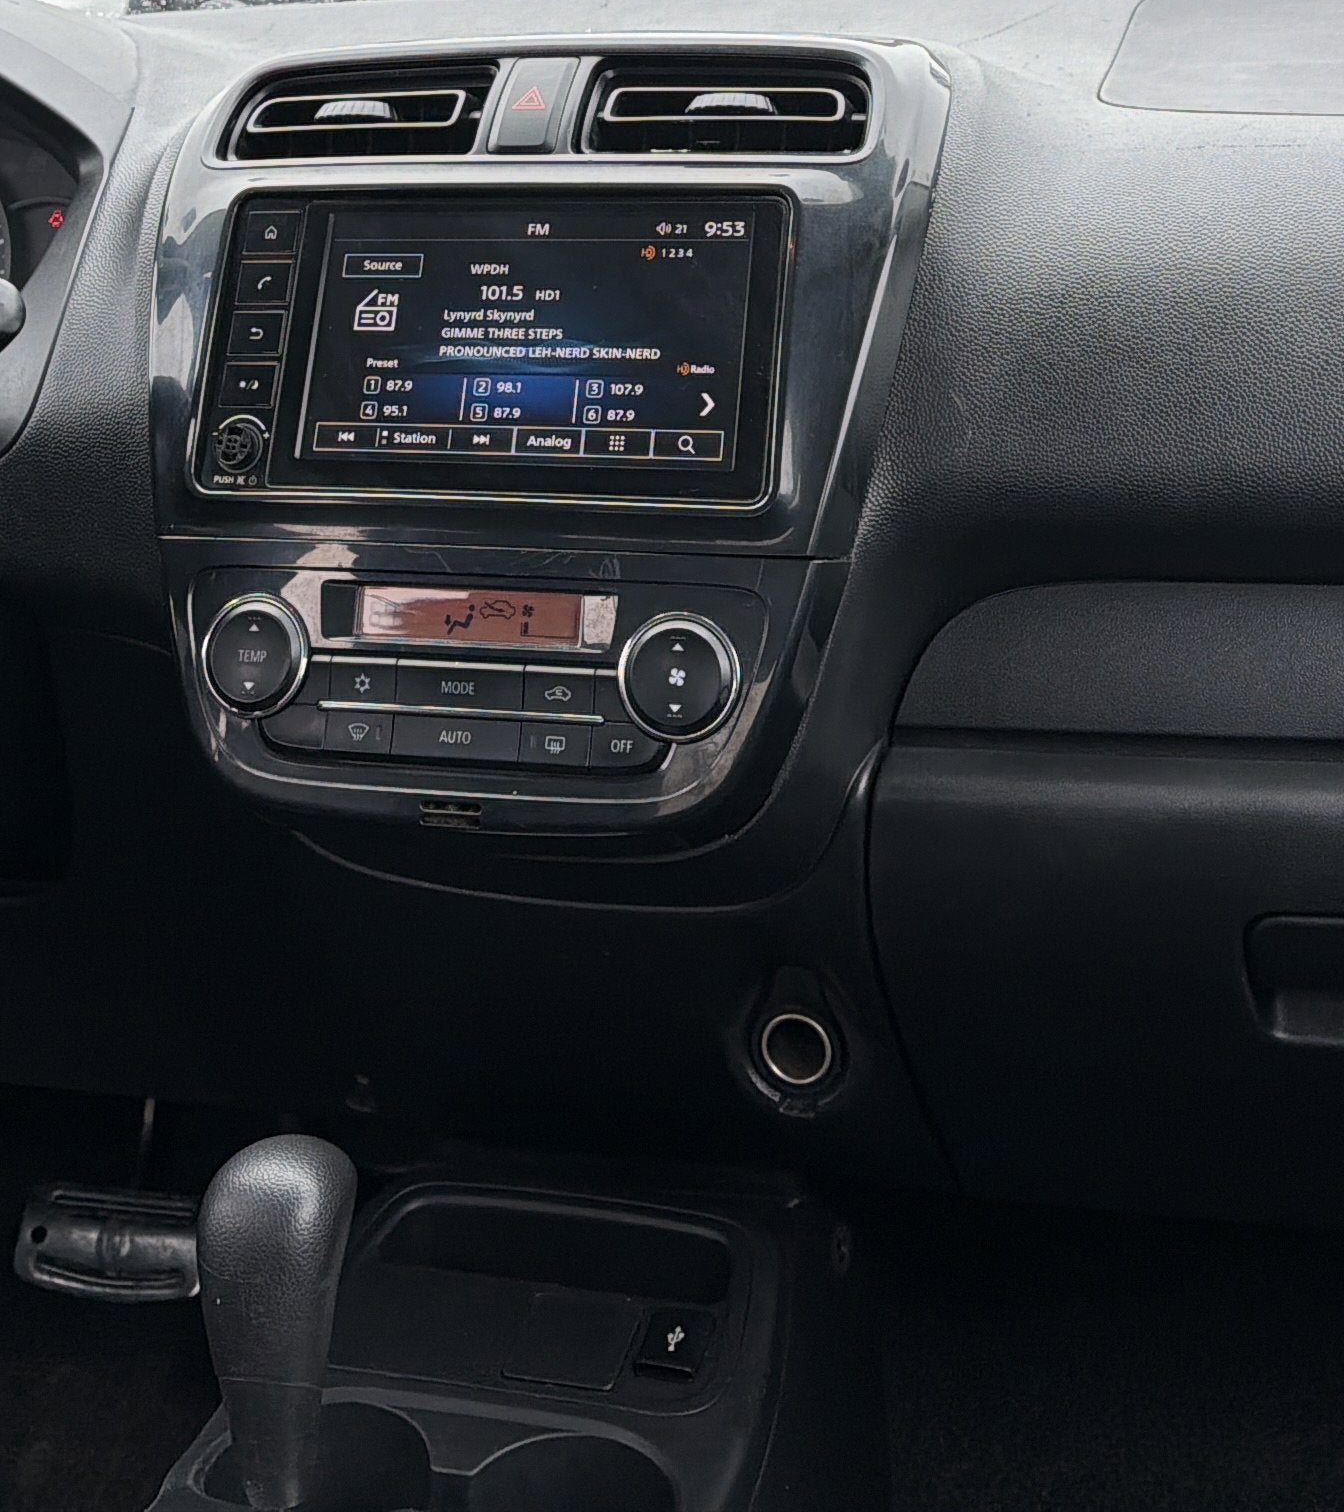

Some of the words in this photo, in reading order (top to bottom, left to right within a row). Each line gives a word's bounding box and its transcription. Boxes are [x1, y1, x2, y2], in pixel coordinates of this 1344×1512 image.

[527, 224, 551, 236] FM
[675, 224, 688, 235] 21
[704, 221, 746, 238] 9:53
[669, 248, 677, 258] 2
[677, 248, 685, 258] 3
[686, 248, 694, 258] 4
[363, 259, 404, 272] Source
[469, 263, 510, 276] WPDH
[377, 292, 400, 306] FM
[480, 285, 525, 301] 101.5
[535, 289, 561, 301] HD1
[443, 309, 484, 323] Lynyrd
[486, 309, 536, 324] Skynyrd
[441, 327, 485, 339] GIMME
[488, 328, 526, 340] THREE
[527, 328, 564, 340] STEPS
[438, 345, 526, 358] PRONOUNCED
[528, 346, 590, 359] LEH-NERD
[592, 347, 662, 361] SKIN-NERD
[366, 357, 399, 369] Preset
[690, 364, 716, 375] Radio
[386, 379, 414, 392] 87.9
[478, 381, 487, 393] 2
[496, 382, 523, 394] 98.1
[590, 383, 599, 395] 3
[609, 383, 645, 396] 107.9
[365, 404, 374, 416] 4
[382, 404, 409, 417] 95.1
[475, 406, 484, 418] 5
[492, 407, 522, 419] 87.9
[587, 409, 597, 421] 6
[606, 409, 636, 422] 87.9
[393, 432, 437, 445] Station
[526, 434, 573, 449] Analog
[213, 474, 235, 485] PUSH
[237, 649, 268, 663] TEMP
[440, 680, 476, 696] MODE
[438, 730, 473, 745] AUTO
[610, 739, 634, 754] OFF
